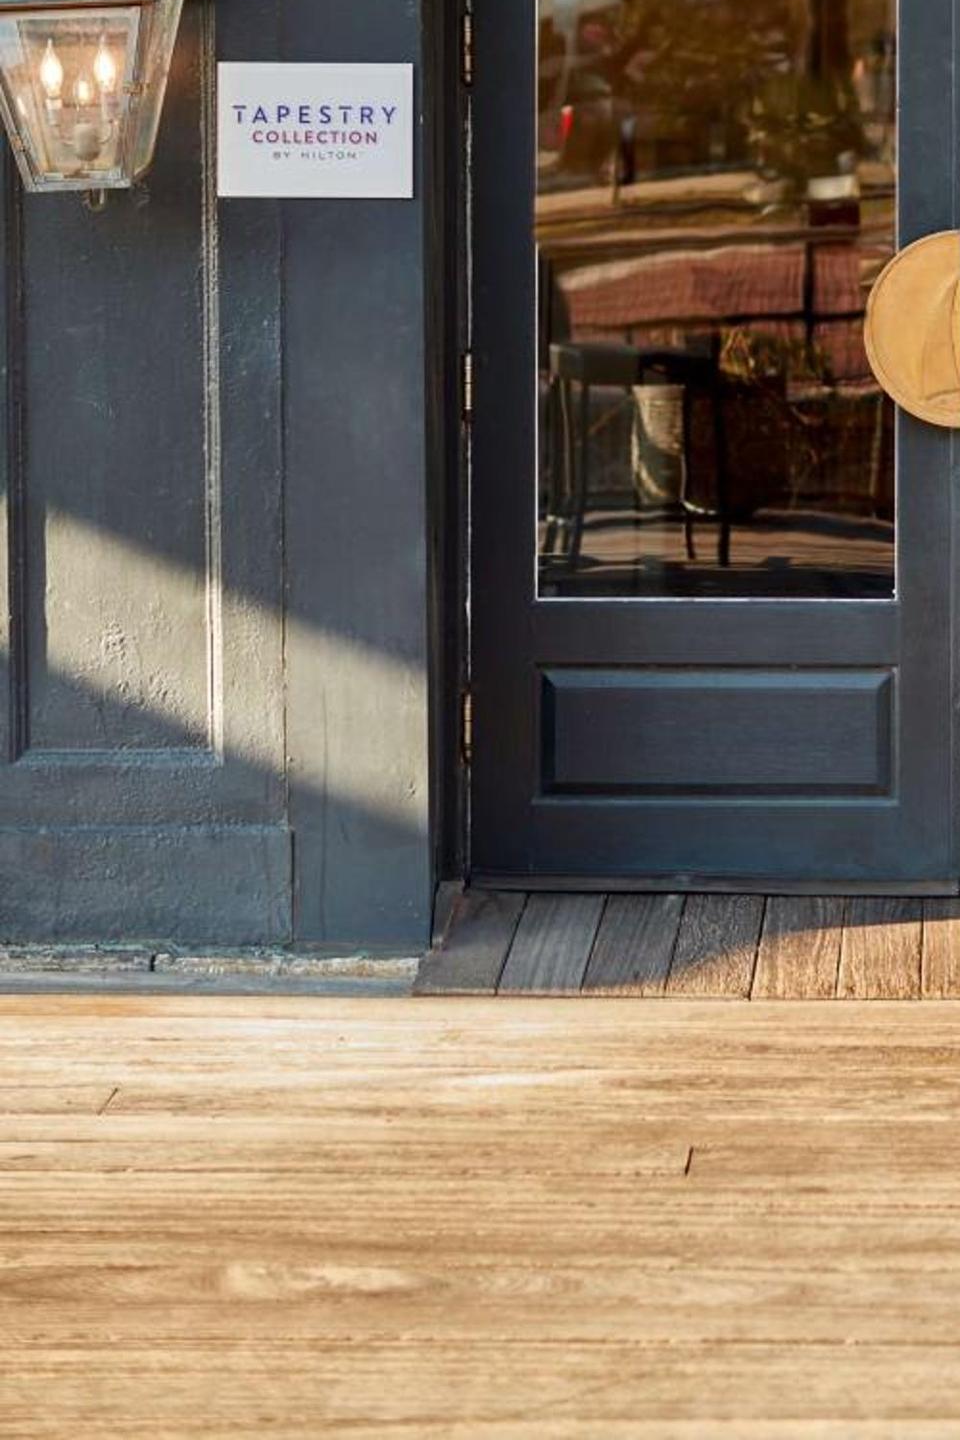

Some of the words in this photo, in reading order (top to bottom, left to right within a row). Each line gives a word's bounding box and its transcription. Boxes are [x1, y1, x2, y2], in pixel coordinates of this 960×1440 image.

[232, 105, 397, 124] TAPESTRY
[252, 130, 377, 145] COLLECTION
[273, 151, 290, 160] BY
[300, 151, 357, 160] HILTON
